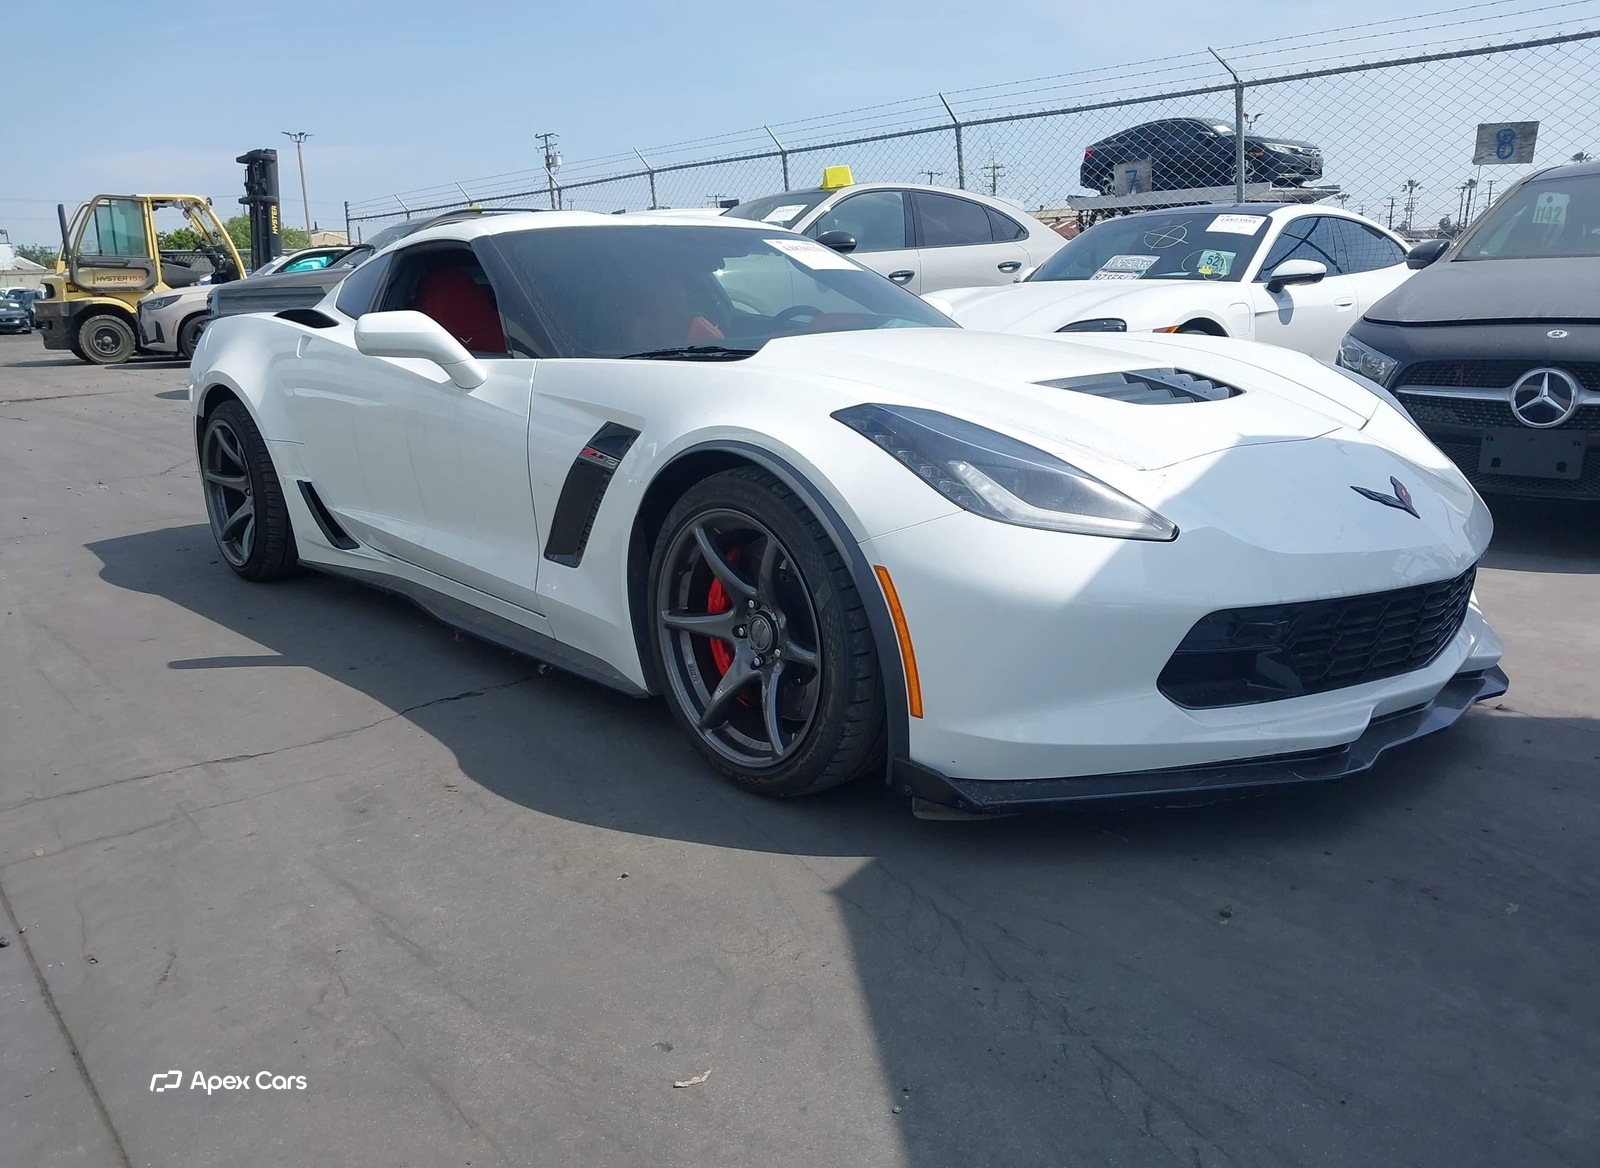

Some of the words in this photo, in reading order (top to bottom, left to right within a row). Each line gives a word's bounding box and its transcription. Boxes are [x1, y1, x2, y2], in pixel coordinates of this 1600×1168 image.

[1496, 128, 1515, 160] 8
[1125, 169, 1138, 194] 7
[271, 205, 279, 235] HYSTER
[1206, 255, 1225, 268] 521
